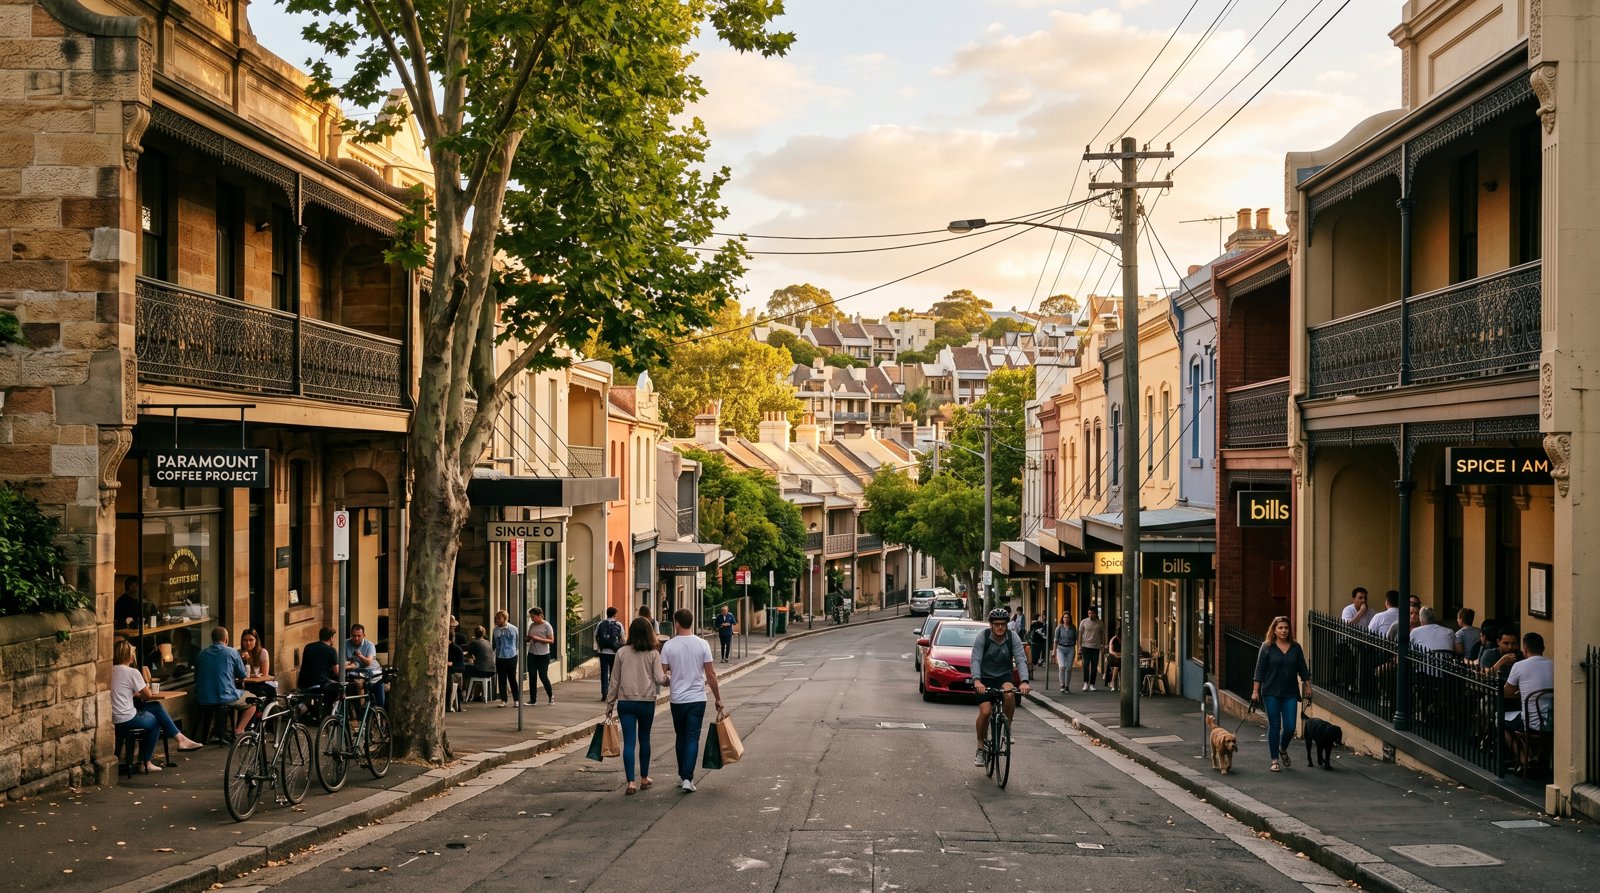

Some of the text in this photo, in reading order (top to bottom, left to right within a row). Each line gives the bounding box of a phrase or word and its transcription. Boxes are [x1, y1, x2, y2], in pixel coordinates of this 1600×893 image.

[157, 455, 258, 469] PARAMOUNT
[1456, 459, 1549, 473] SPICE I AM
[157, 471, 258, 481] COFFEE PROJECT
[1251, 499, 1290, 520] bills
[495, 526, 554, 538] SINGLE O
[1162, 558, 1192, 574] bills
